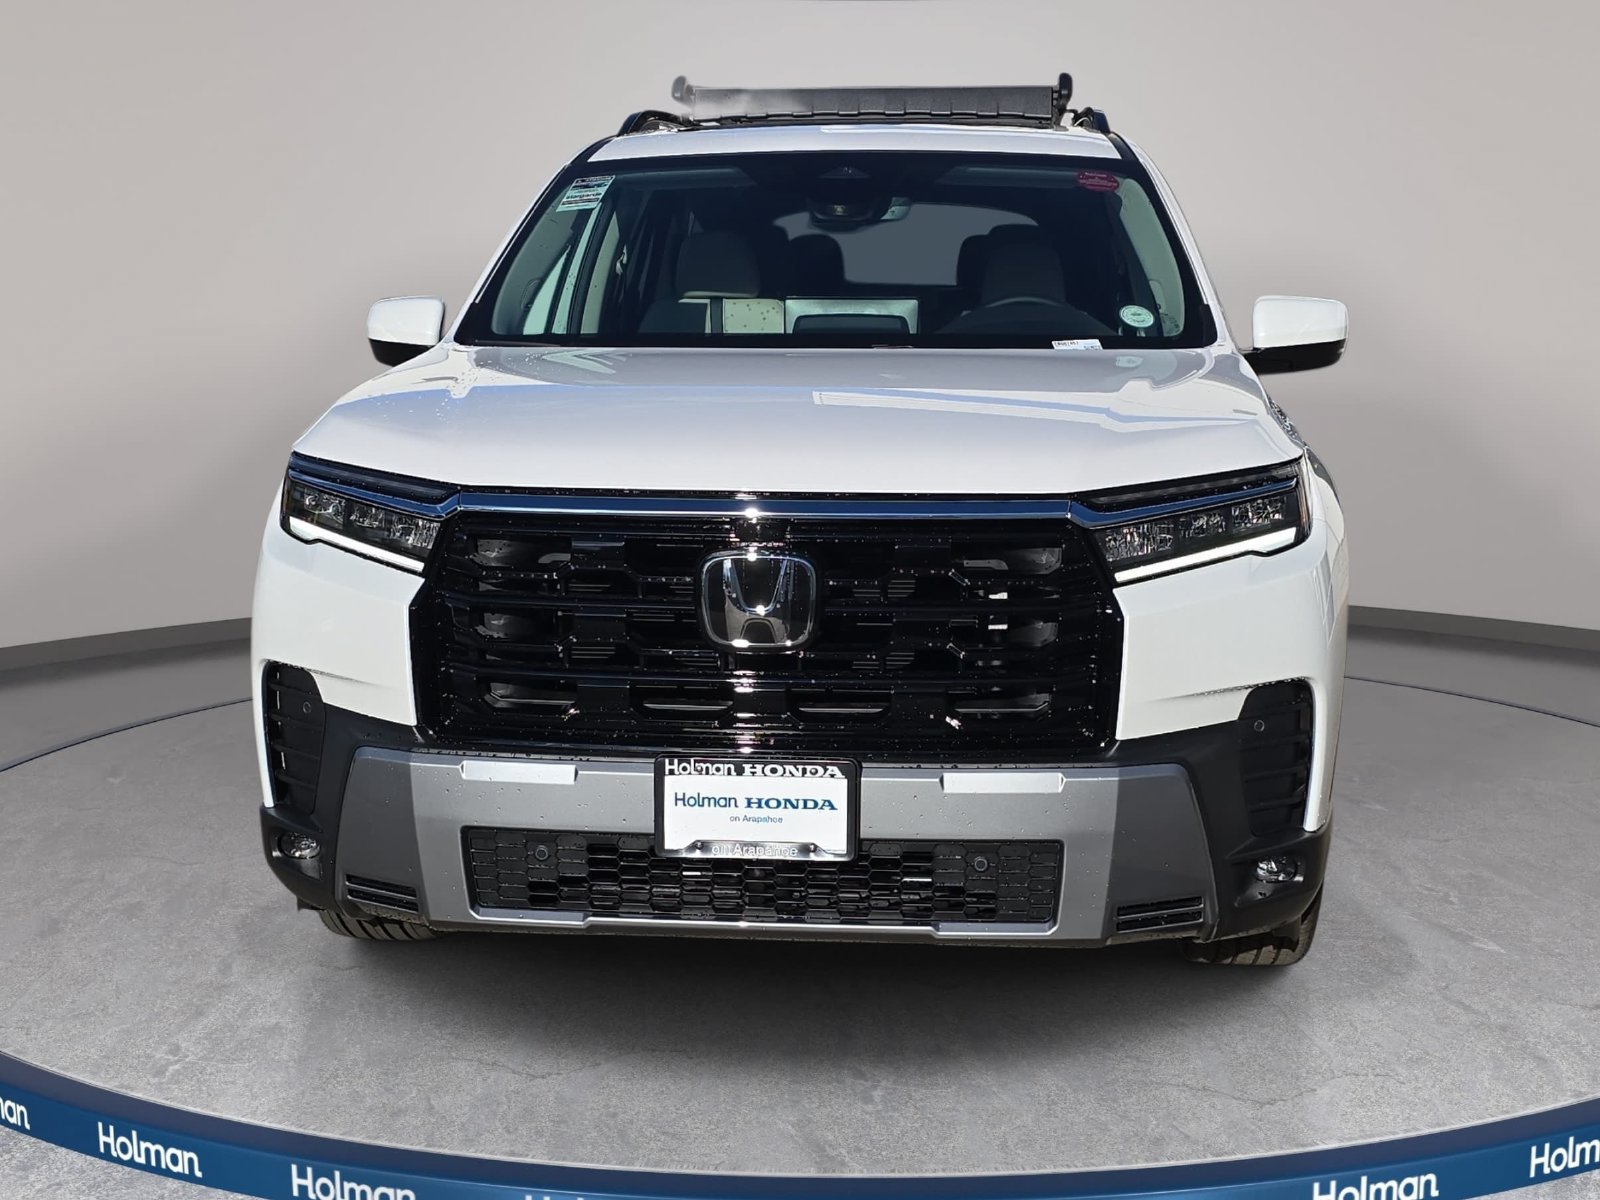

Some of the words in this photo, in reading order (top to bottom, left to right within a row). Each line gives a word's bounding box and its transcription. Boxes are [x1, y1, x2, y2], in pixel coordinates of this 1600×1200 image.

[665, 758, 737, 776] Holman
[743, 764, 845, 778] HONDA
[674, 792, 738, 808] Holman
[745, 798, 838, 811] HONDA
[729, 815, 741, 823] on
[742, 814, 784, 824] Arapahoe
[97, 1121, 203, 1178] Holman
